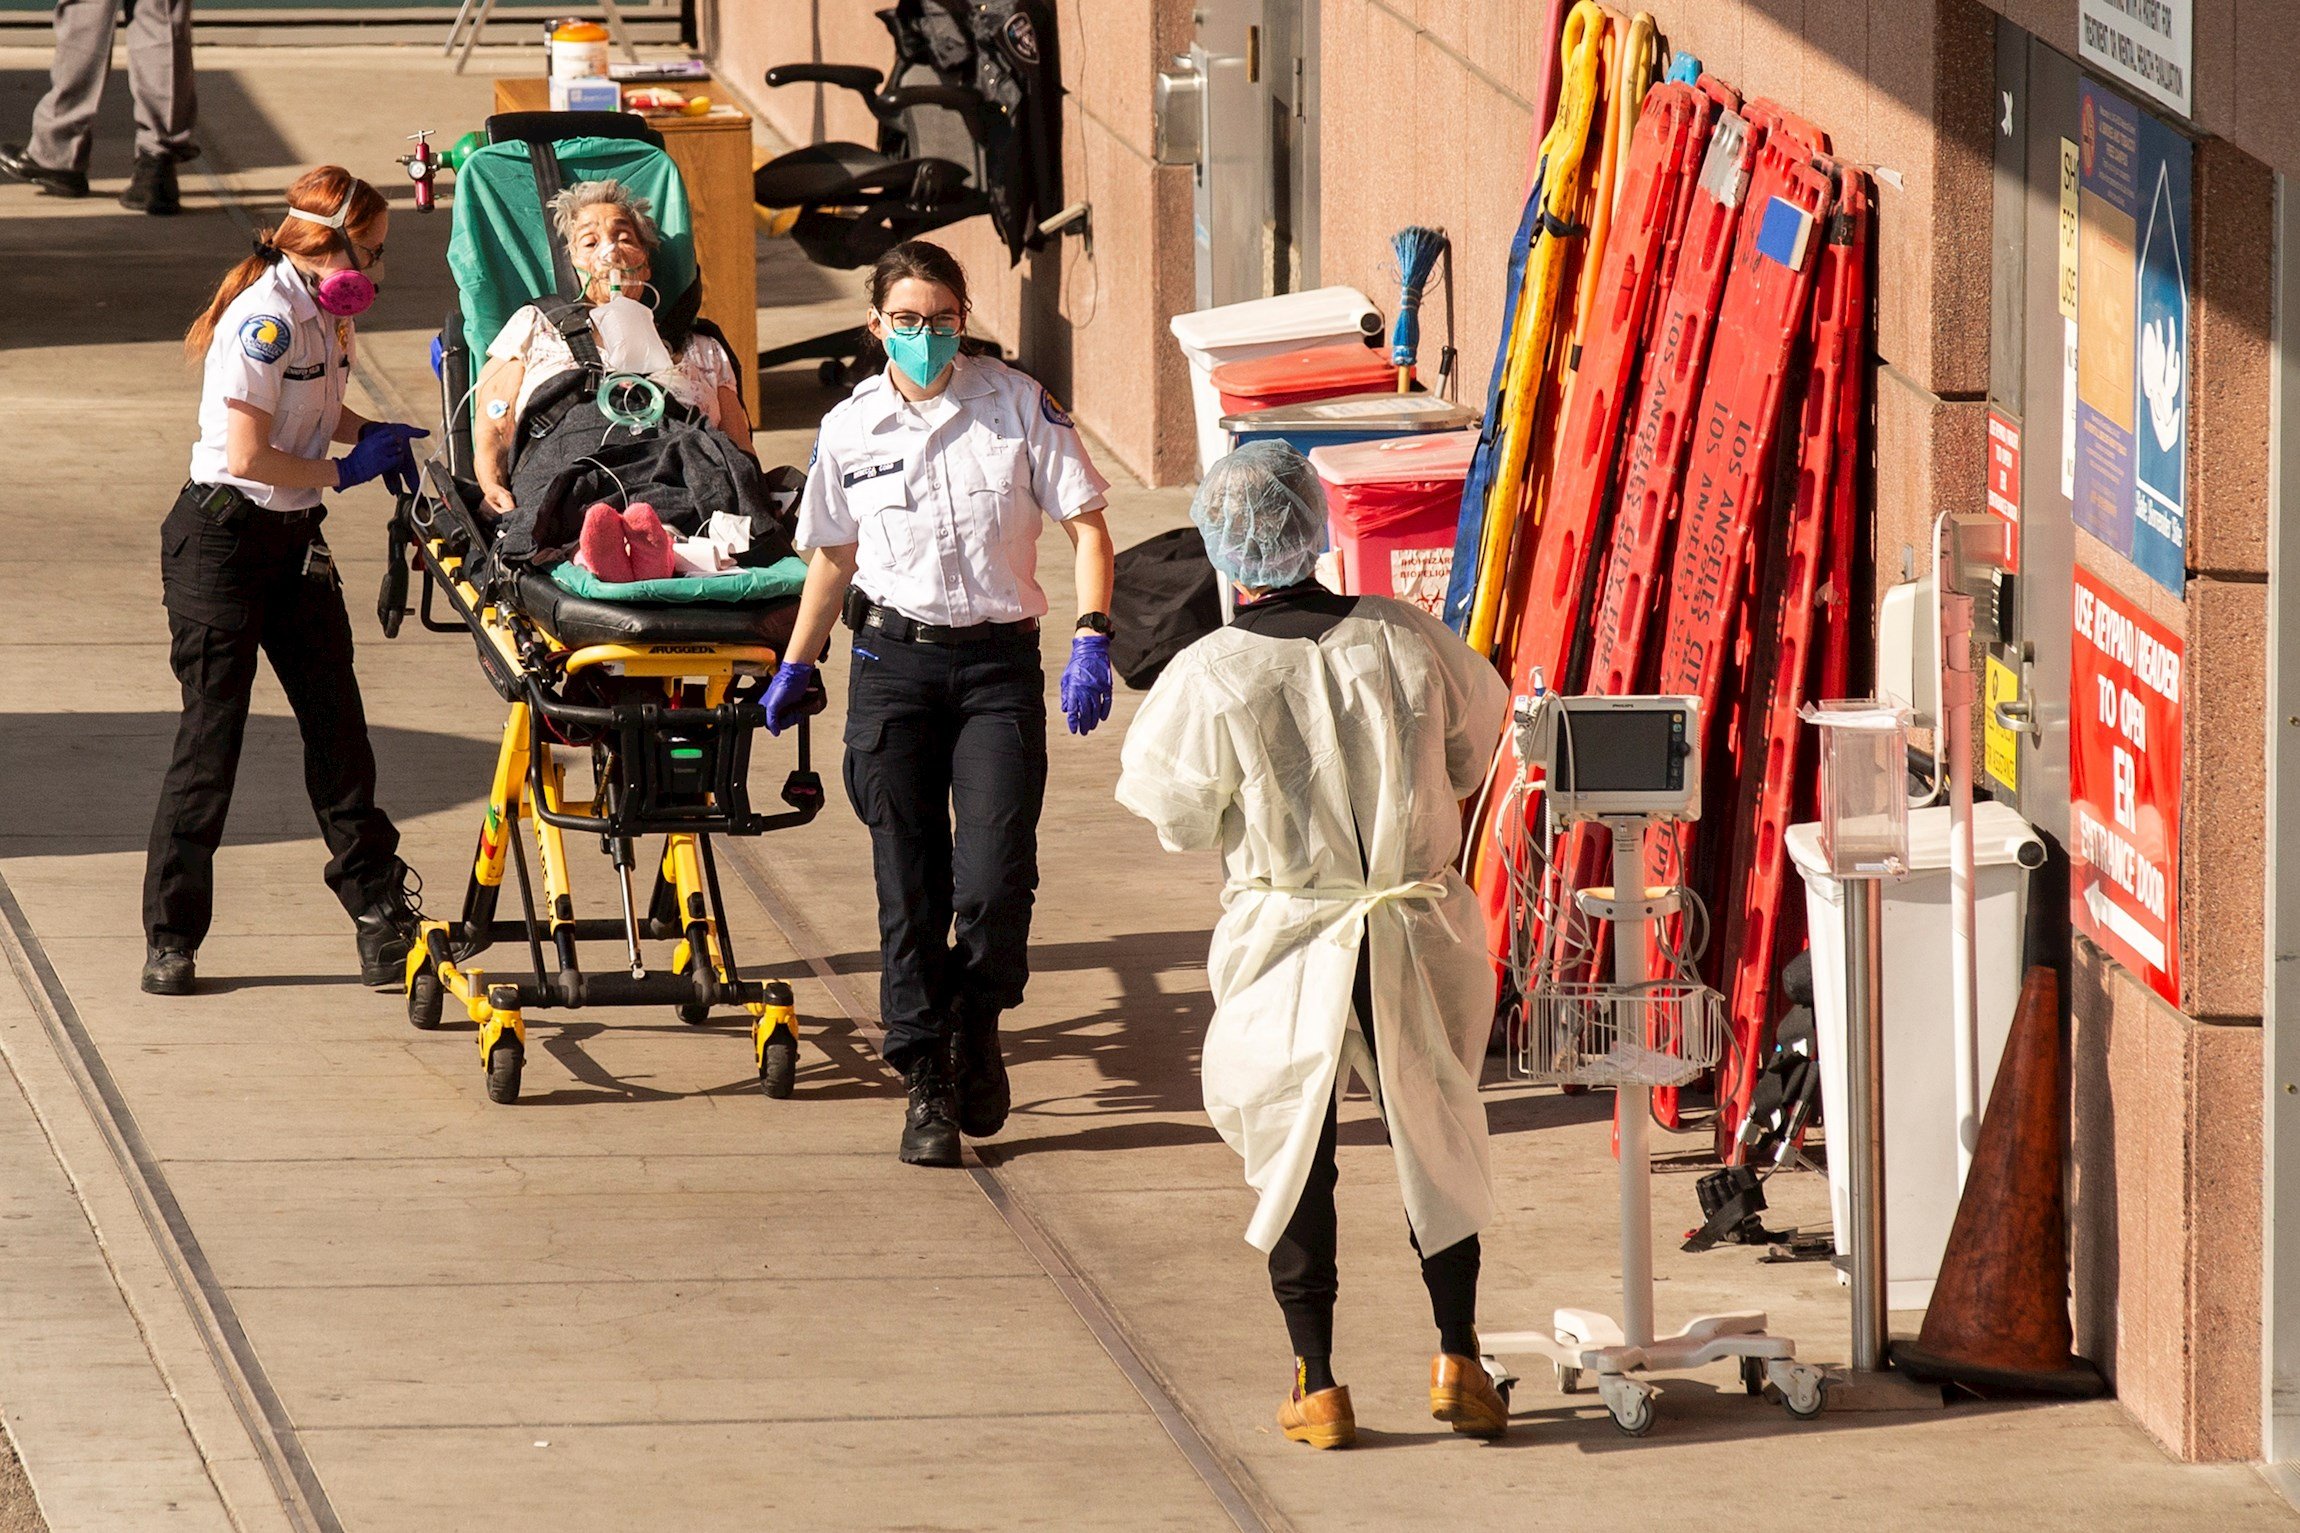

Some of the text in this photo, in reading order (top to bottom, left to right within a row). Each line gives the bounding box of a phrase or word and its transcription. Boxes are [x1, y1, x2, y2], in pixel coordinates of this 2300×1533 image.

[2062, 208, 2076, 250] FOR
[2062, 264, 2076, 307] USE
[1706, 401, 1729, 454] LOS
[1728, 420, 1752, 477] LOS
[1602, 310, 1683, 673] LOS ANGELES CITY FIRE
[1697, 489, 1735, 626] ANGELES
[2074, 582, 2094, 641] USE
[656, 645, 708, 654] RUGGED
[1684, 639, 1705, 691] CIT
[2098, 673, 2146, 753] TO OPEN
[2113, 745, 2136, 834] ER
[2080, 810, 2166, 923] ENTRANCE DOOR
